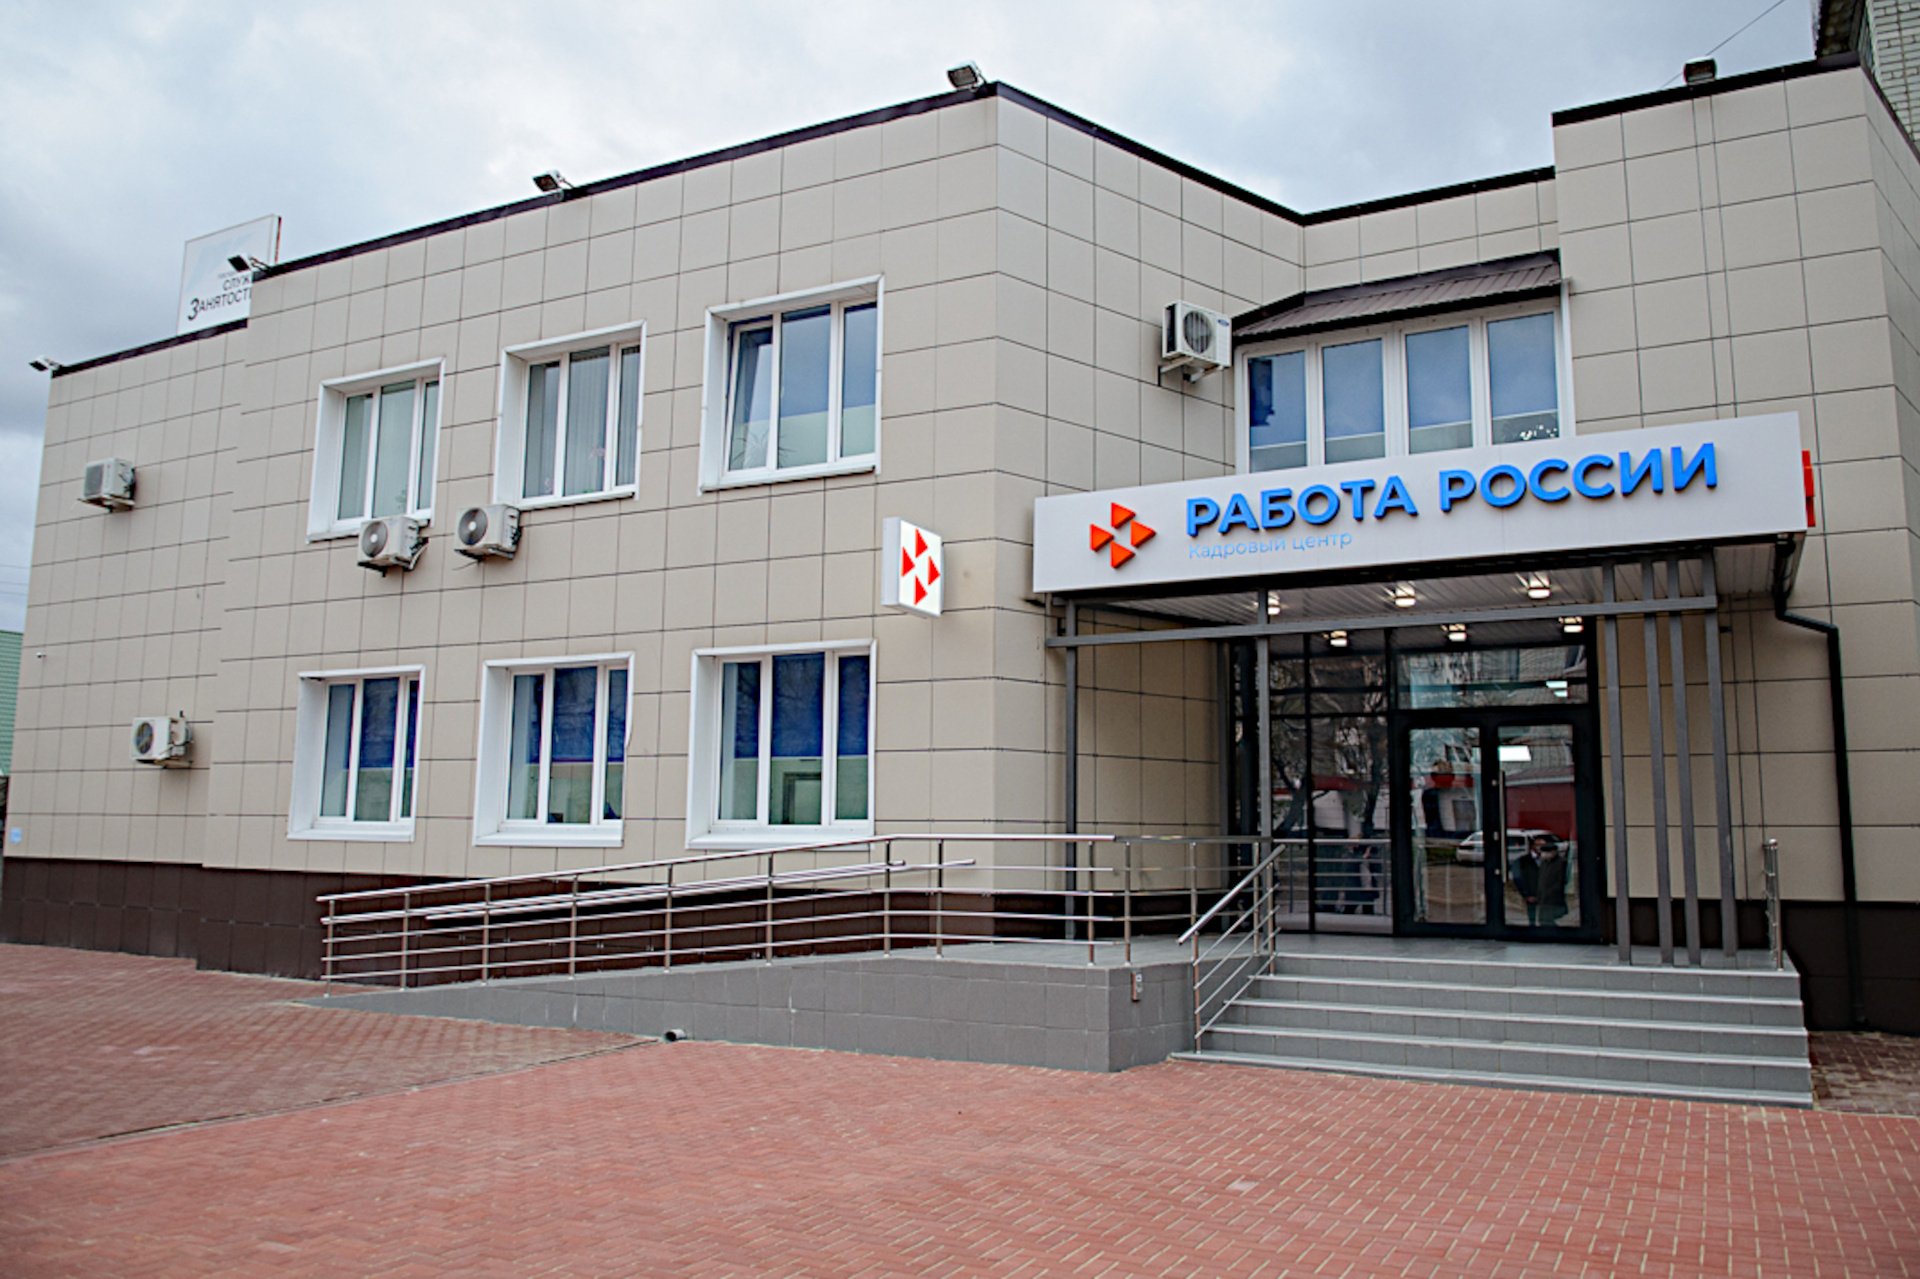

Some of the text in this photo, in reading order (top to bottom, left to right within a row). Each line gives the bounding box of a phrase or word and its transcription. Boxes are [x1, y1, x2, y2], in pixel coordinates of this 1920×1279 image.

[1186, 442, 1718, 537] РАБОТА РОССИИ
[1189, 531, 1353, 560] Кадровый центр
